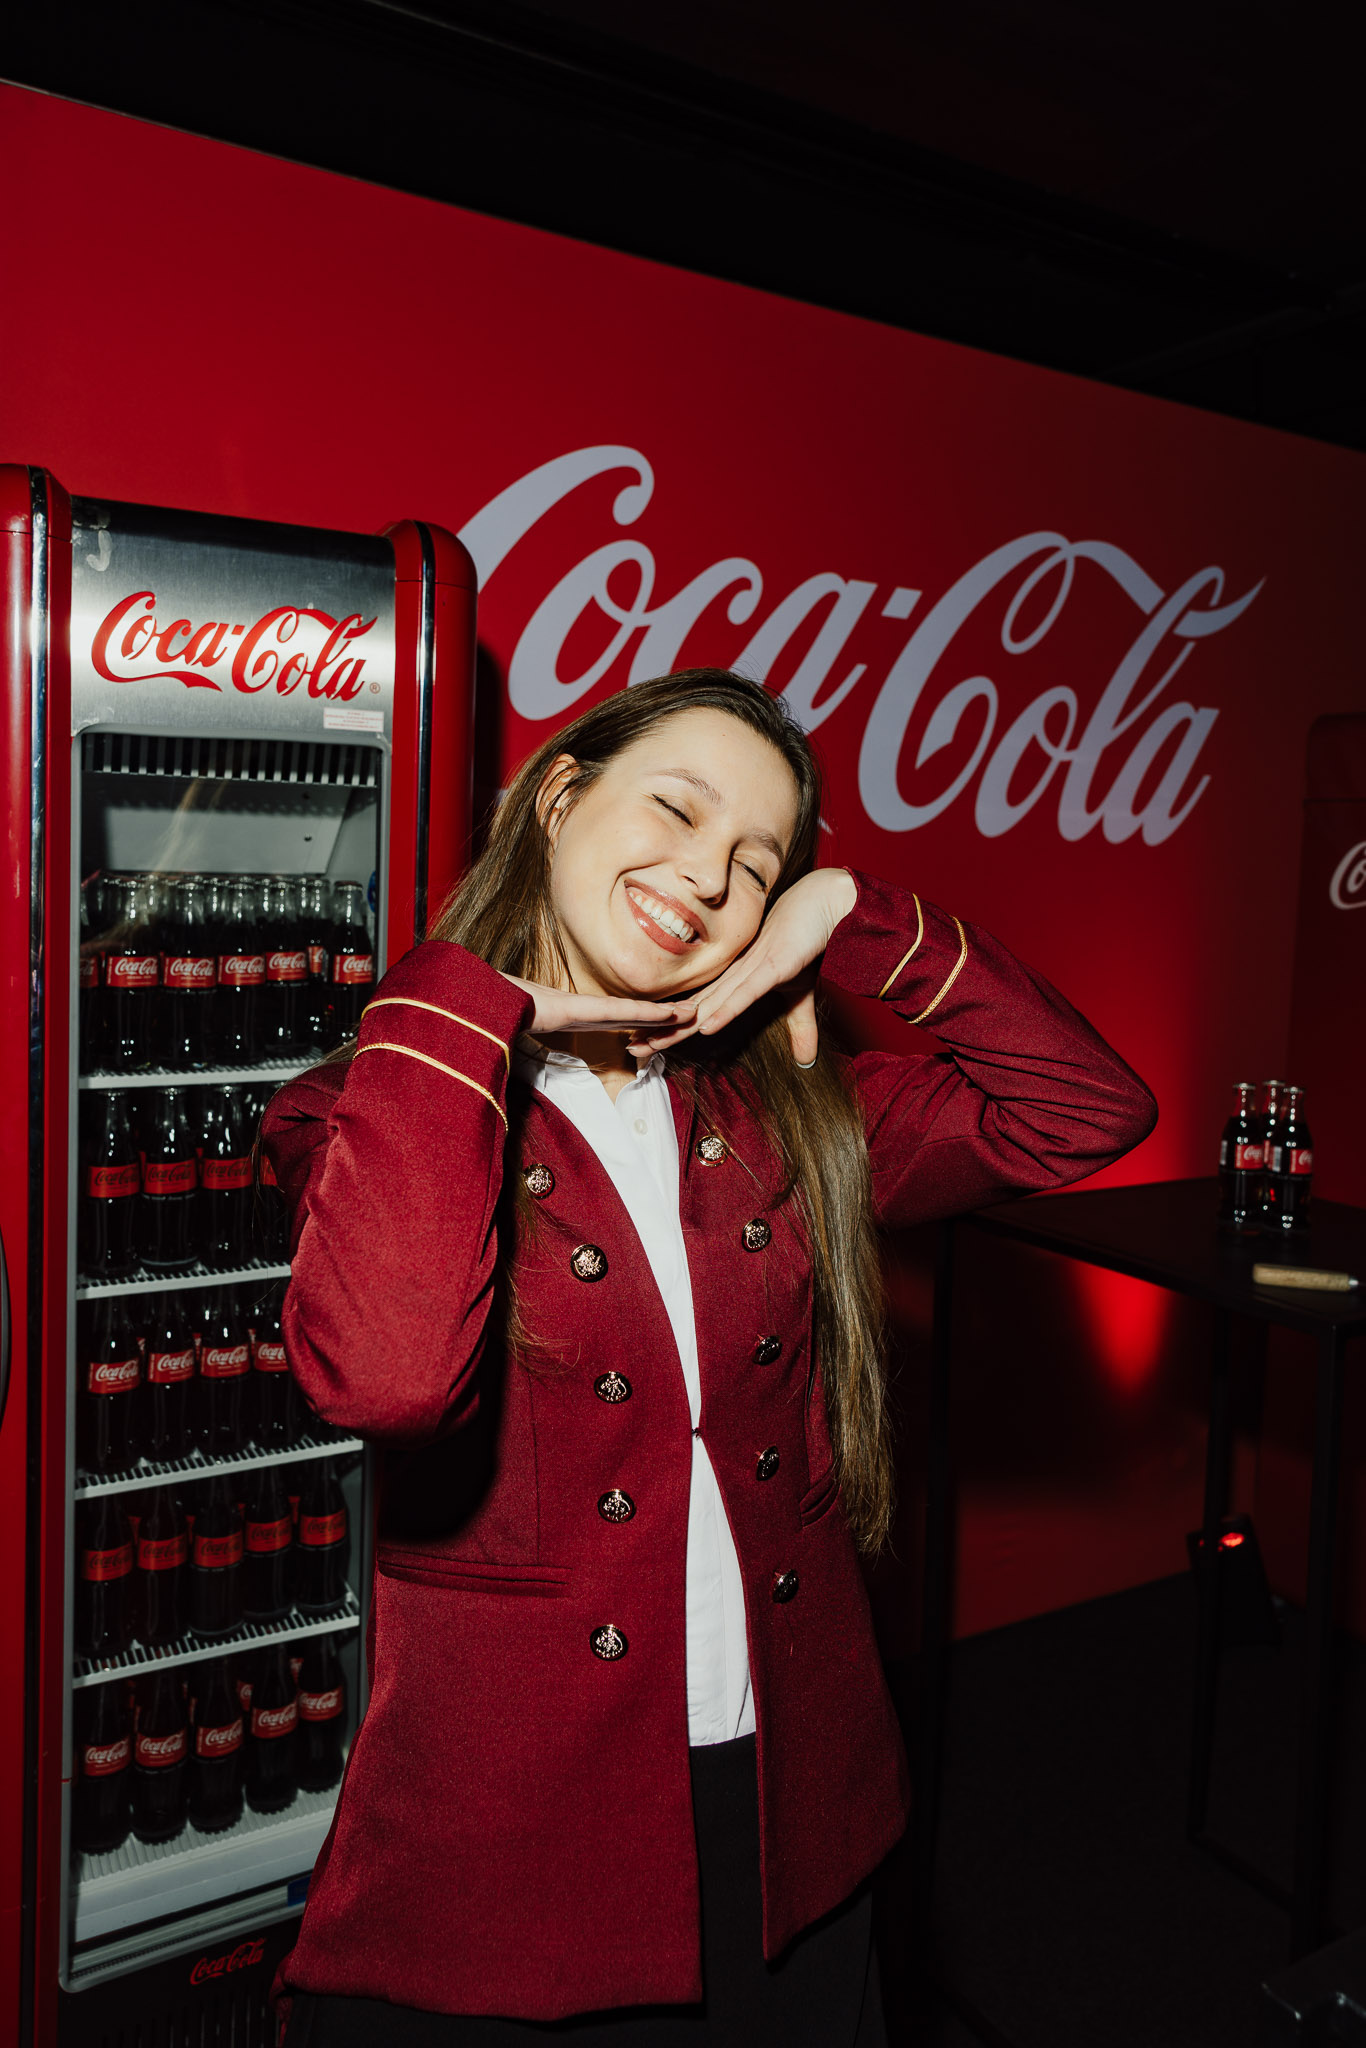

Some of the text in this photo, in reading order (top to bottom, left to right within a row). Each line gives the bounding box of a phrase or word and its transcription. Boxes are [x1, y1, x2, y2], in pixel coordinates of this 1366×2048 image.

[91, 590, 378, 701] Coca-Cola
[457, 444, 1266, 848] Coca-Cola
[114, 957, 158, 976] Coca-Cola
[170, 958, 214, 977] Coca-Cola
[206, 1345, 249, 1366] Coca-Cola
[84, 1737, 128, 1764] Coca-Cola
[140, 1732, 184, 1755] Coca-Cola
[189, 1936, 268, 1985] Coca-Cola
